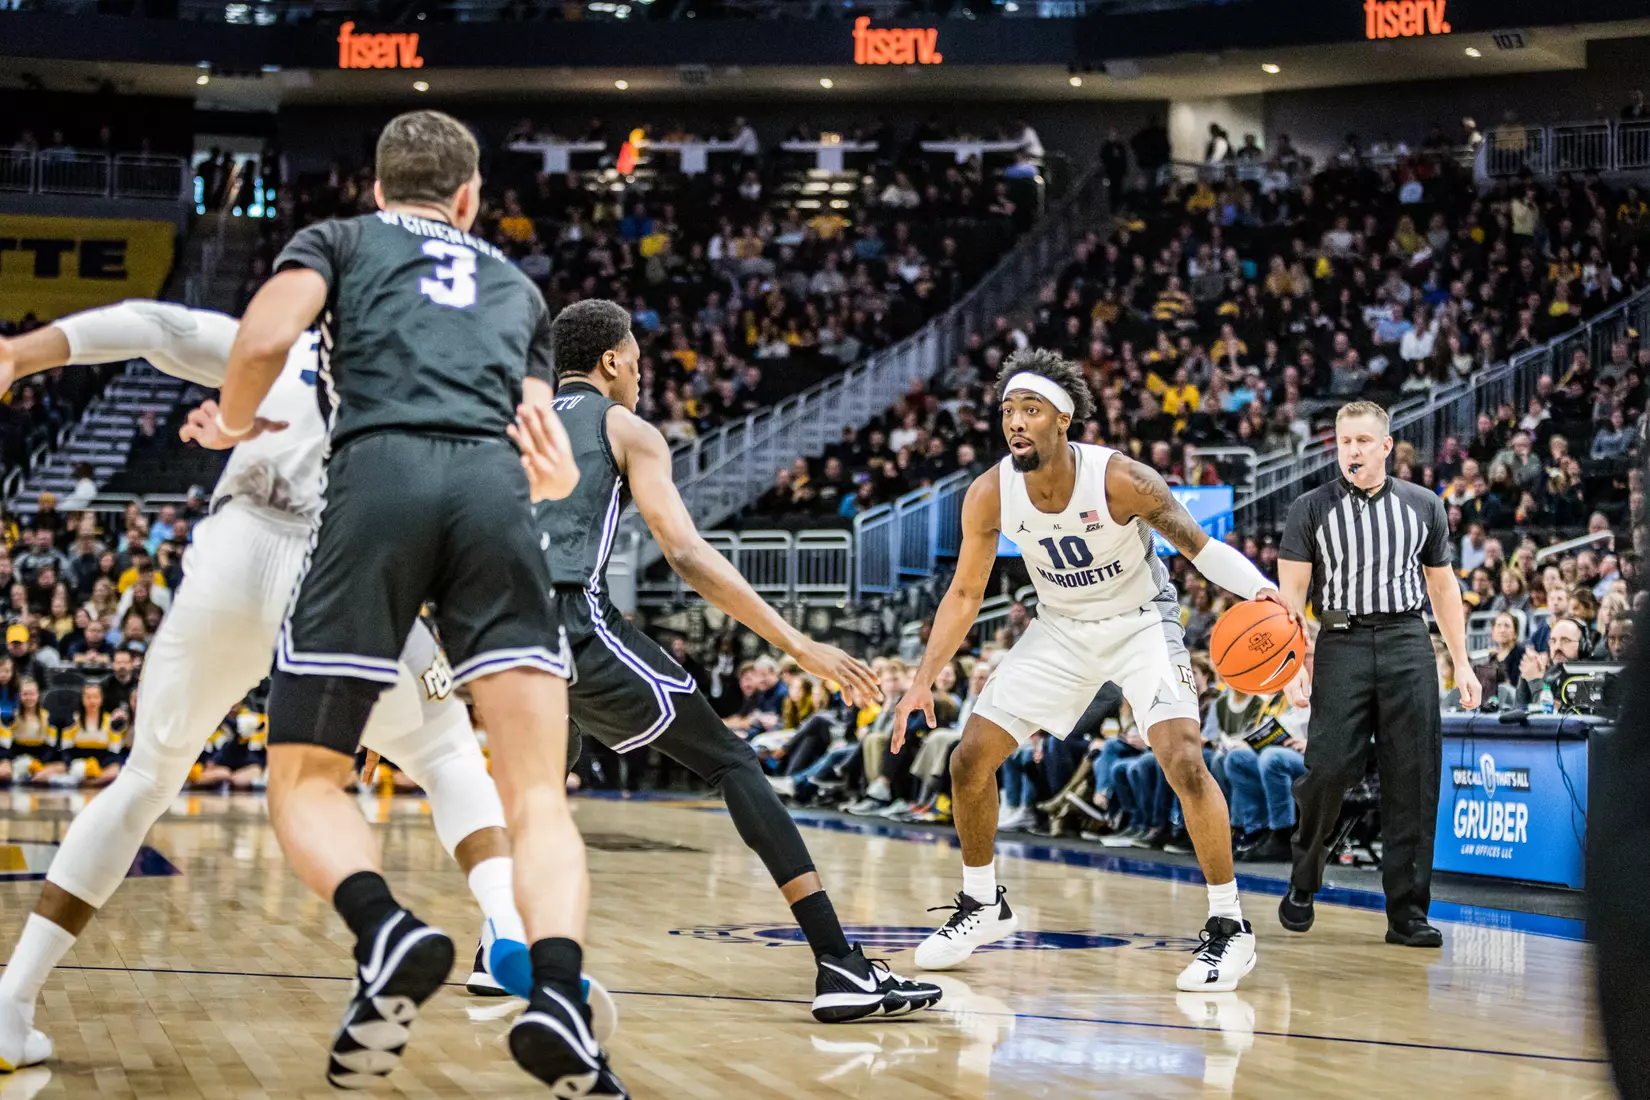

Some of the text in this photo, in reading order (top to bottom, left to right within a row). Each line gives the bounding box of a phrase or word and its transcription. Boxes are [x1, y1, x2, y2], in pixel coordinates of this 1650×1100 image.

[419, 239, 477, 309] 3
[1038, 535, 1094, 570] 10
[1036, 560, 1124, 588] MARQUETTE
[1466, 770, 1483, 786] CALL
[1516, 772, 1530, 788] ALL
[1453, 798, 1528, 843] GRUBER
[1461, 844, 1514, 859] LAW OFFICES LLC
